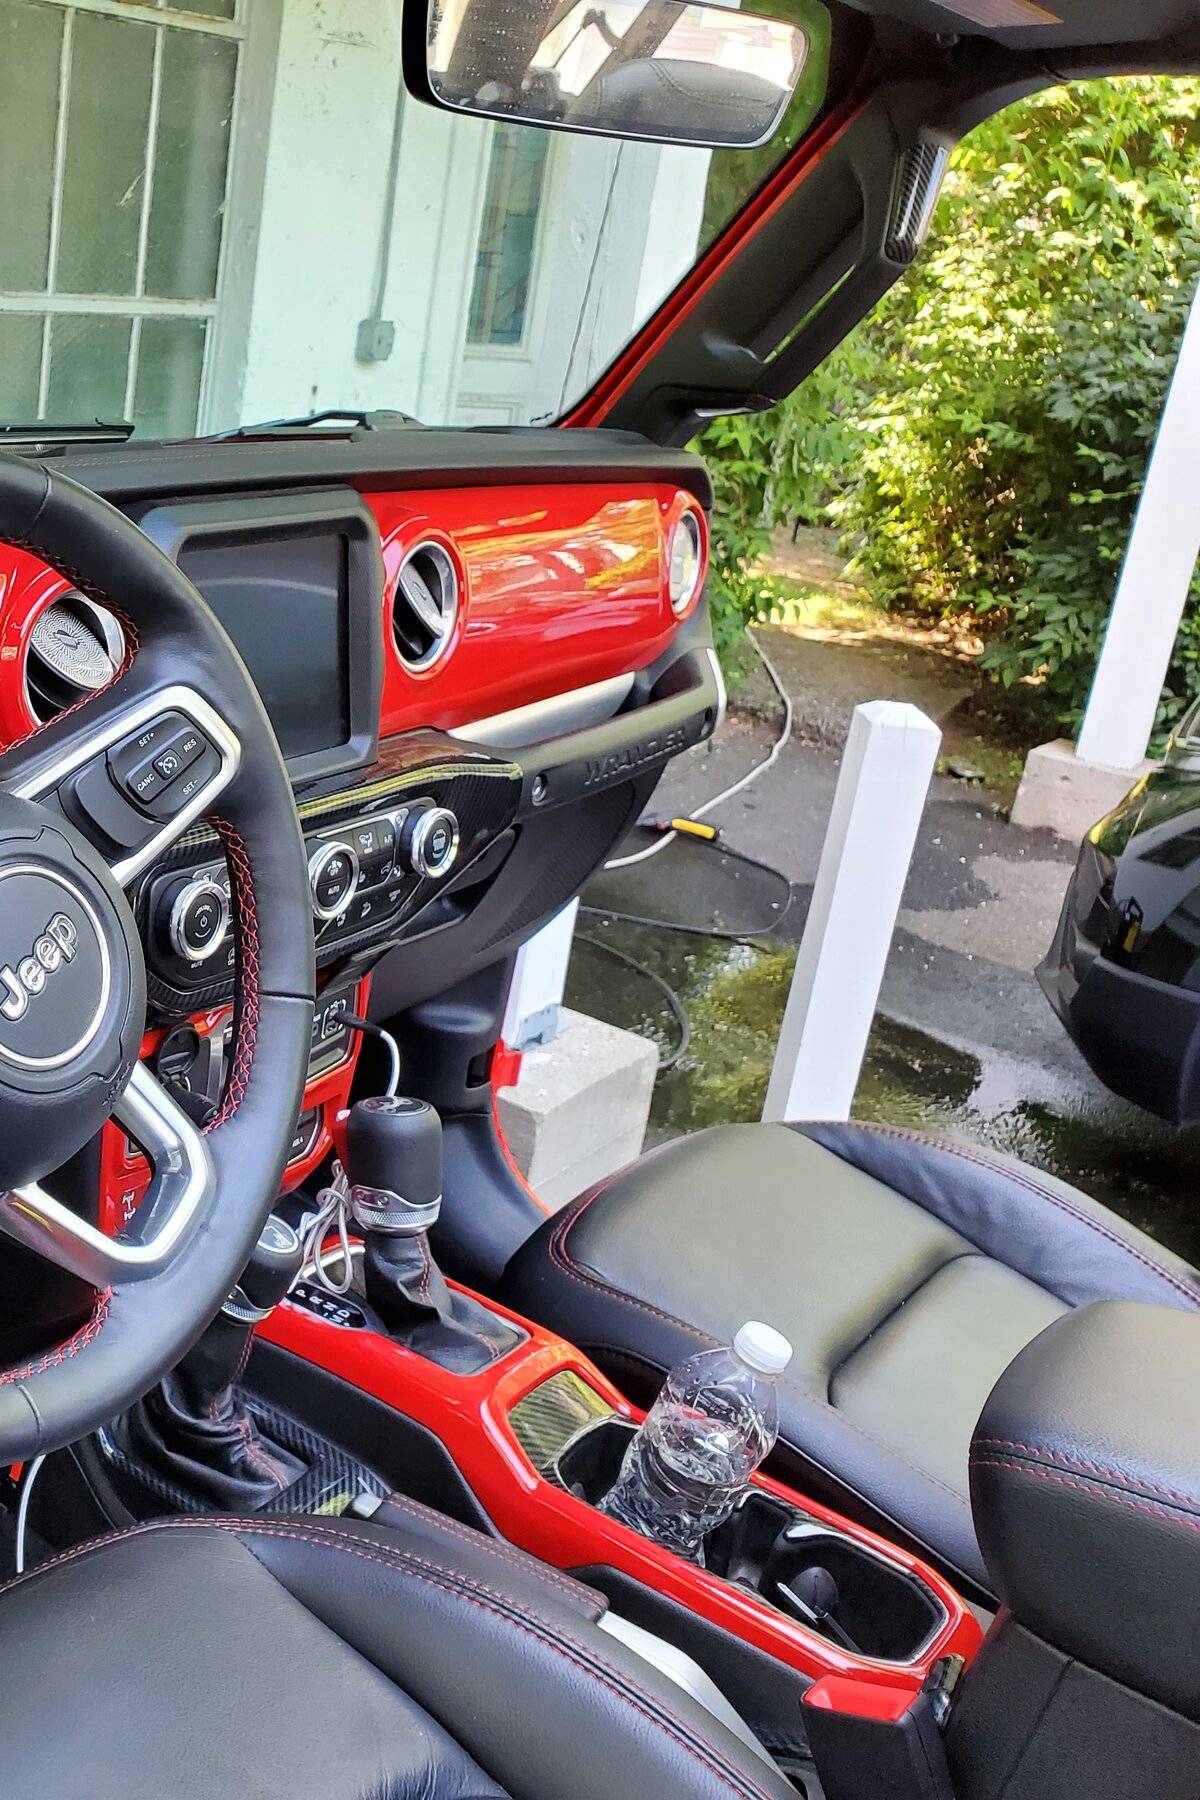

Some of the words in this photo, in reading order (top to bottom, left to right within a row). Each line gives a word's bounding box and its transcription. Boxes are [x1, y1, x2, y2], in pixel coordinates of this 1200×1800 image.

[183, 738, 197, 753] RES
[137, 773, 155, 791] CANC
[295, 1289, 307, 1298] P
[309, 1295, 323, 1304] R
